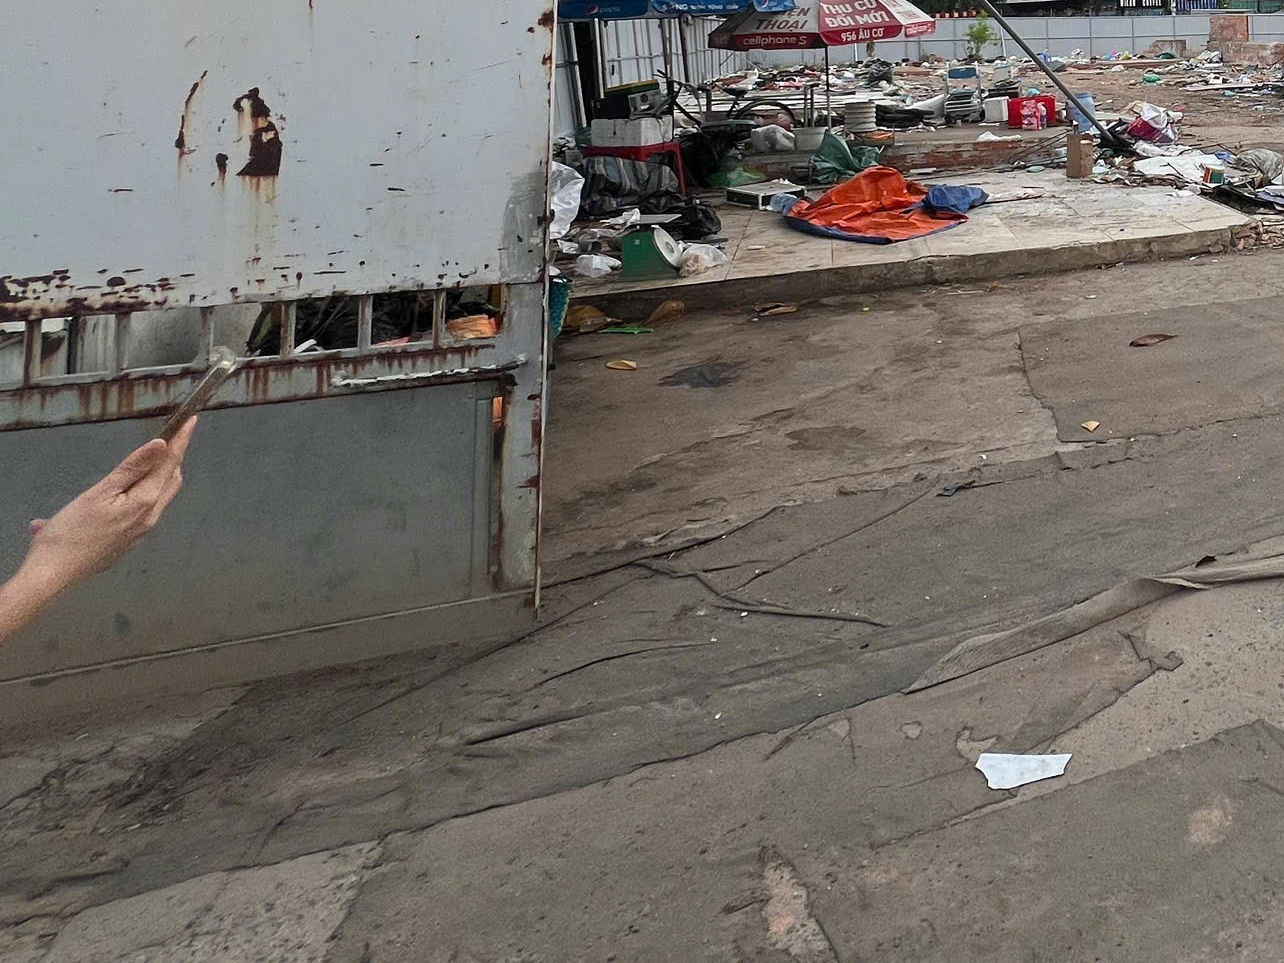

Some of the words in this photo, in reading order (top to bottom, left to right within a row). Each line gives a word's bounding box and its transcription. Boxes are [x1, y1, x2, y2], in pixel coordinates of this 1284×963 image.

[820, 3, 853, 14] THU
[855, 10, 890, 25] MỚI
[756, 19, 808, 32] THOẠI
[743, 35, 797, 47] cellphone
[841, 31, 857, 42] 956
[858, 27, 870, 40] ÂU
[872, 27, 885, 38] CƠ
